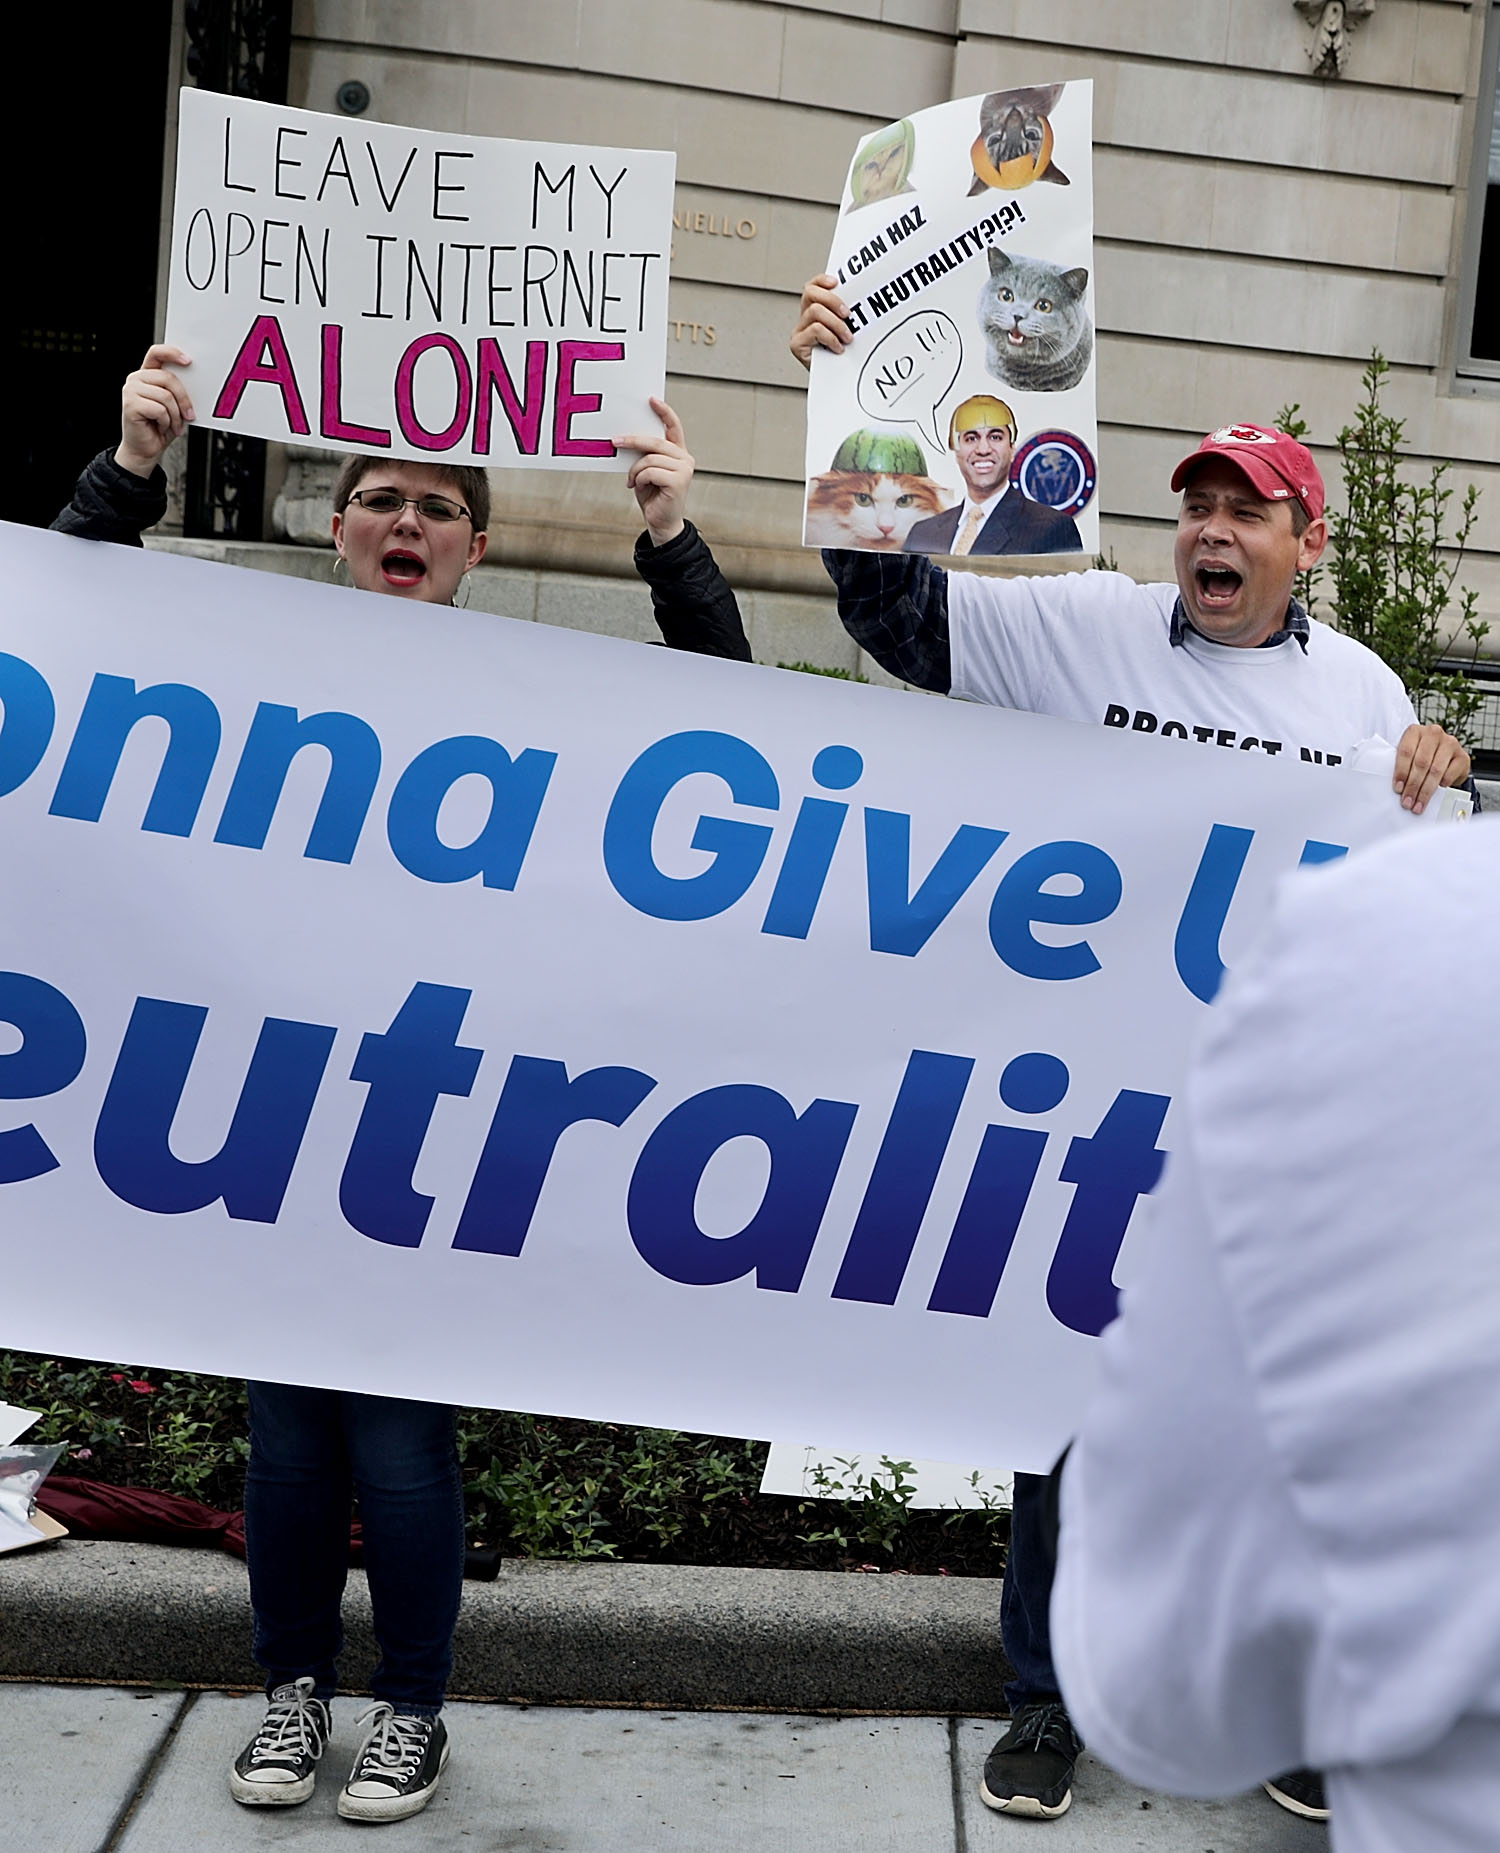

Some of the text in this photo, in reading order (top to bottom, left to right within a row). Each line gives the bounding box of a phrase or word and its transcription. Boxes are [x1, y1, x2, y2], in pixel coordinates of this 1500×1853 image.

[223, 116, 627, 239] LEAVE MY
[185, 208, 661, 333] OPEN INTERNET
[843, 200, 1027, 334] ET NEUTRALITY?!?!
[847, 235, 888, 276] CAN
[886, 205, 927, 246] HAZ
[212, 315, 625, 458] ALONE
[670, 320, 717, 346] TTS
[874, 355, 914, 399] NO
[603, 729, 1123, 980] Give
